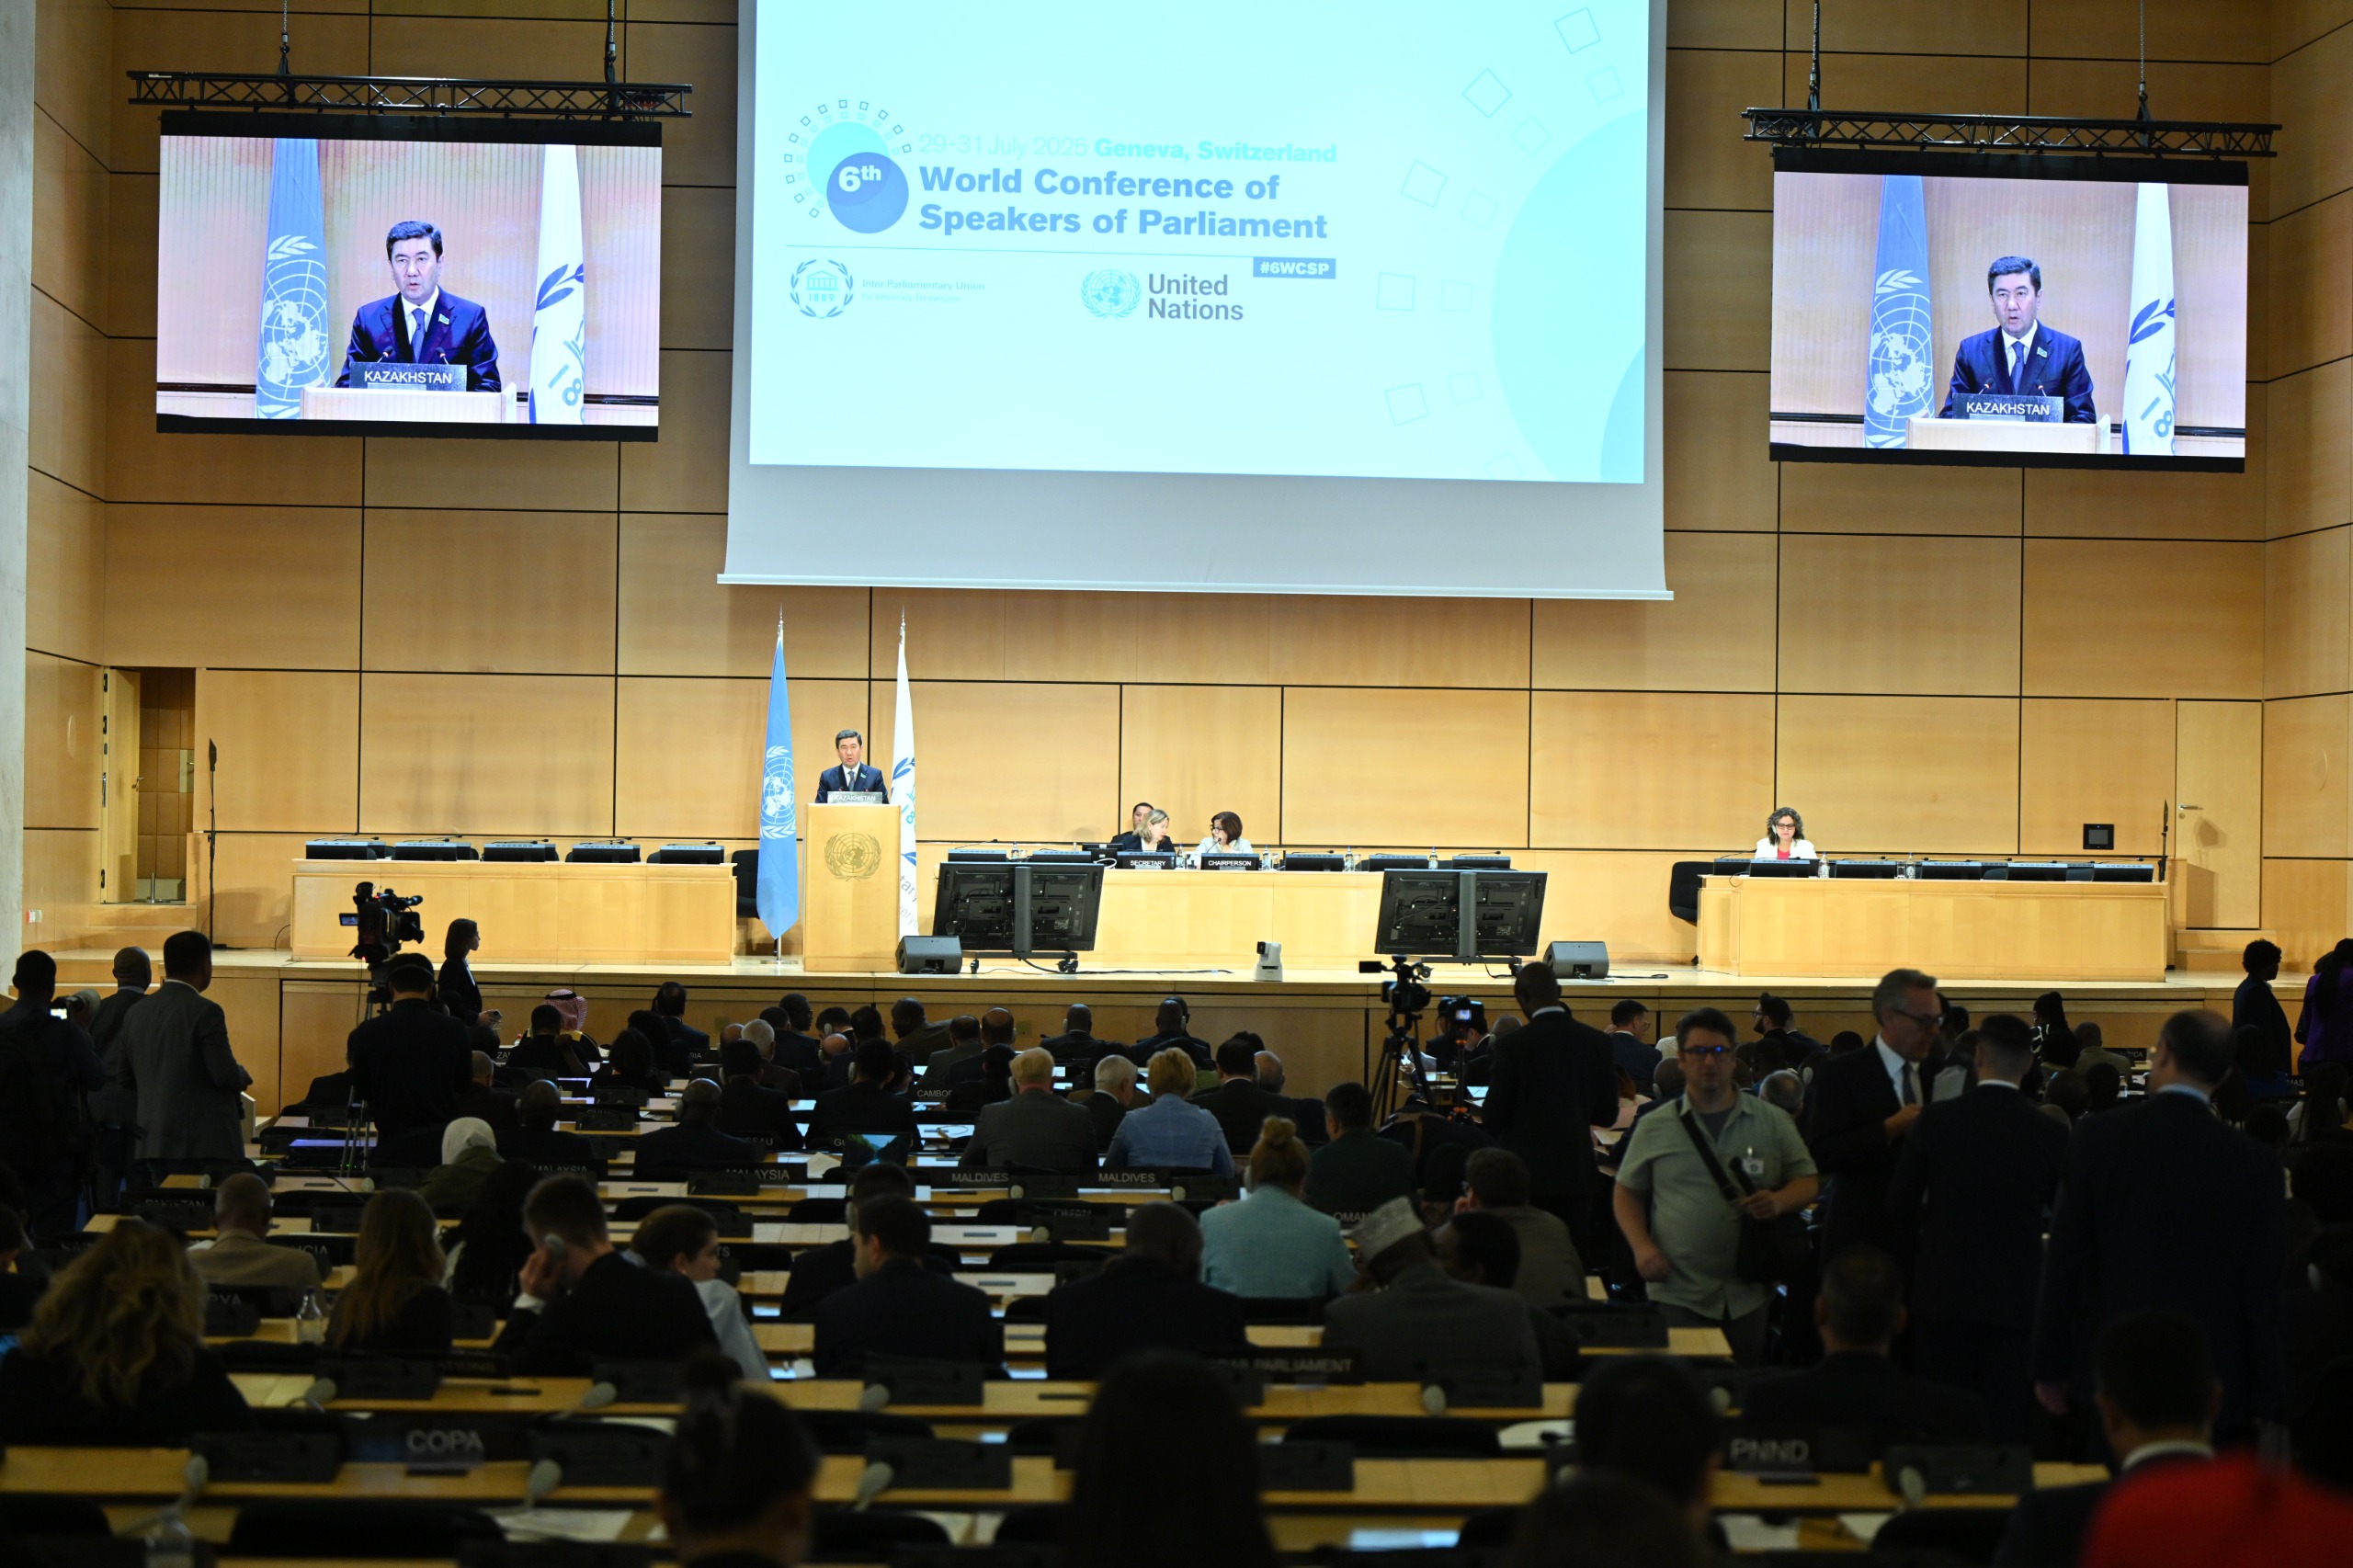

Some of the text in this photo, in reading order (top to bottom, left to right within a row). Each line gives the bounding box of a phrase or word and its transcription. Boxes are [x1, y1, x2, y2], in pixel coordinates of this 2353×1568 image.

[919, 134, 1337, 164] 29-31 July 2025 Geneva, Switzerland
[838, 165, 881, 192] 6th
[919, 166, 1279, 199] World Conference of
[919, 204, 1328, 238] Speakers of Parliament
[1260, 261, 1329, 276] #6WCSP
[862, 279, 985, 291] Inter-Parliamentary Union
[1149, 273, 1228, 296] United
[809, 293, 835, 301] 1889
[1149, 298, 1244, 320] Nations
[364, 370, 452, 384] KAZAKHSTAN
[1967, 402, 2050, 415] KAZAKHSTAN
[917, 1089, 953, 1097] CAMBO
[951, 1172, 1009, 1183] MALDIVES
[1098, 1172, 1155, 1183] MALDIVES
[406, 1428, 485, 1454] COPA
